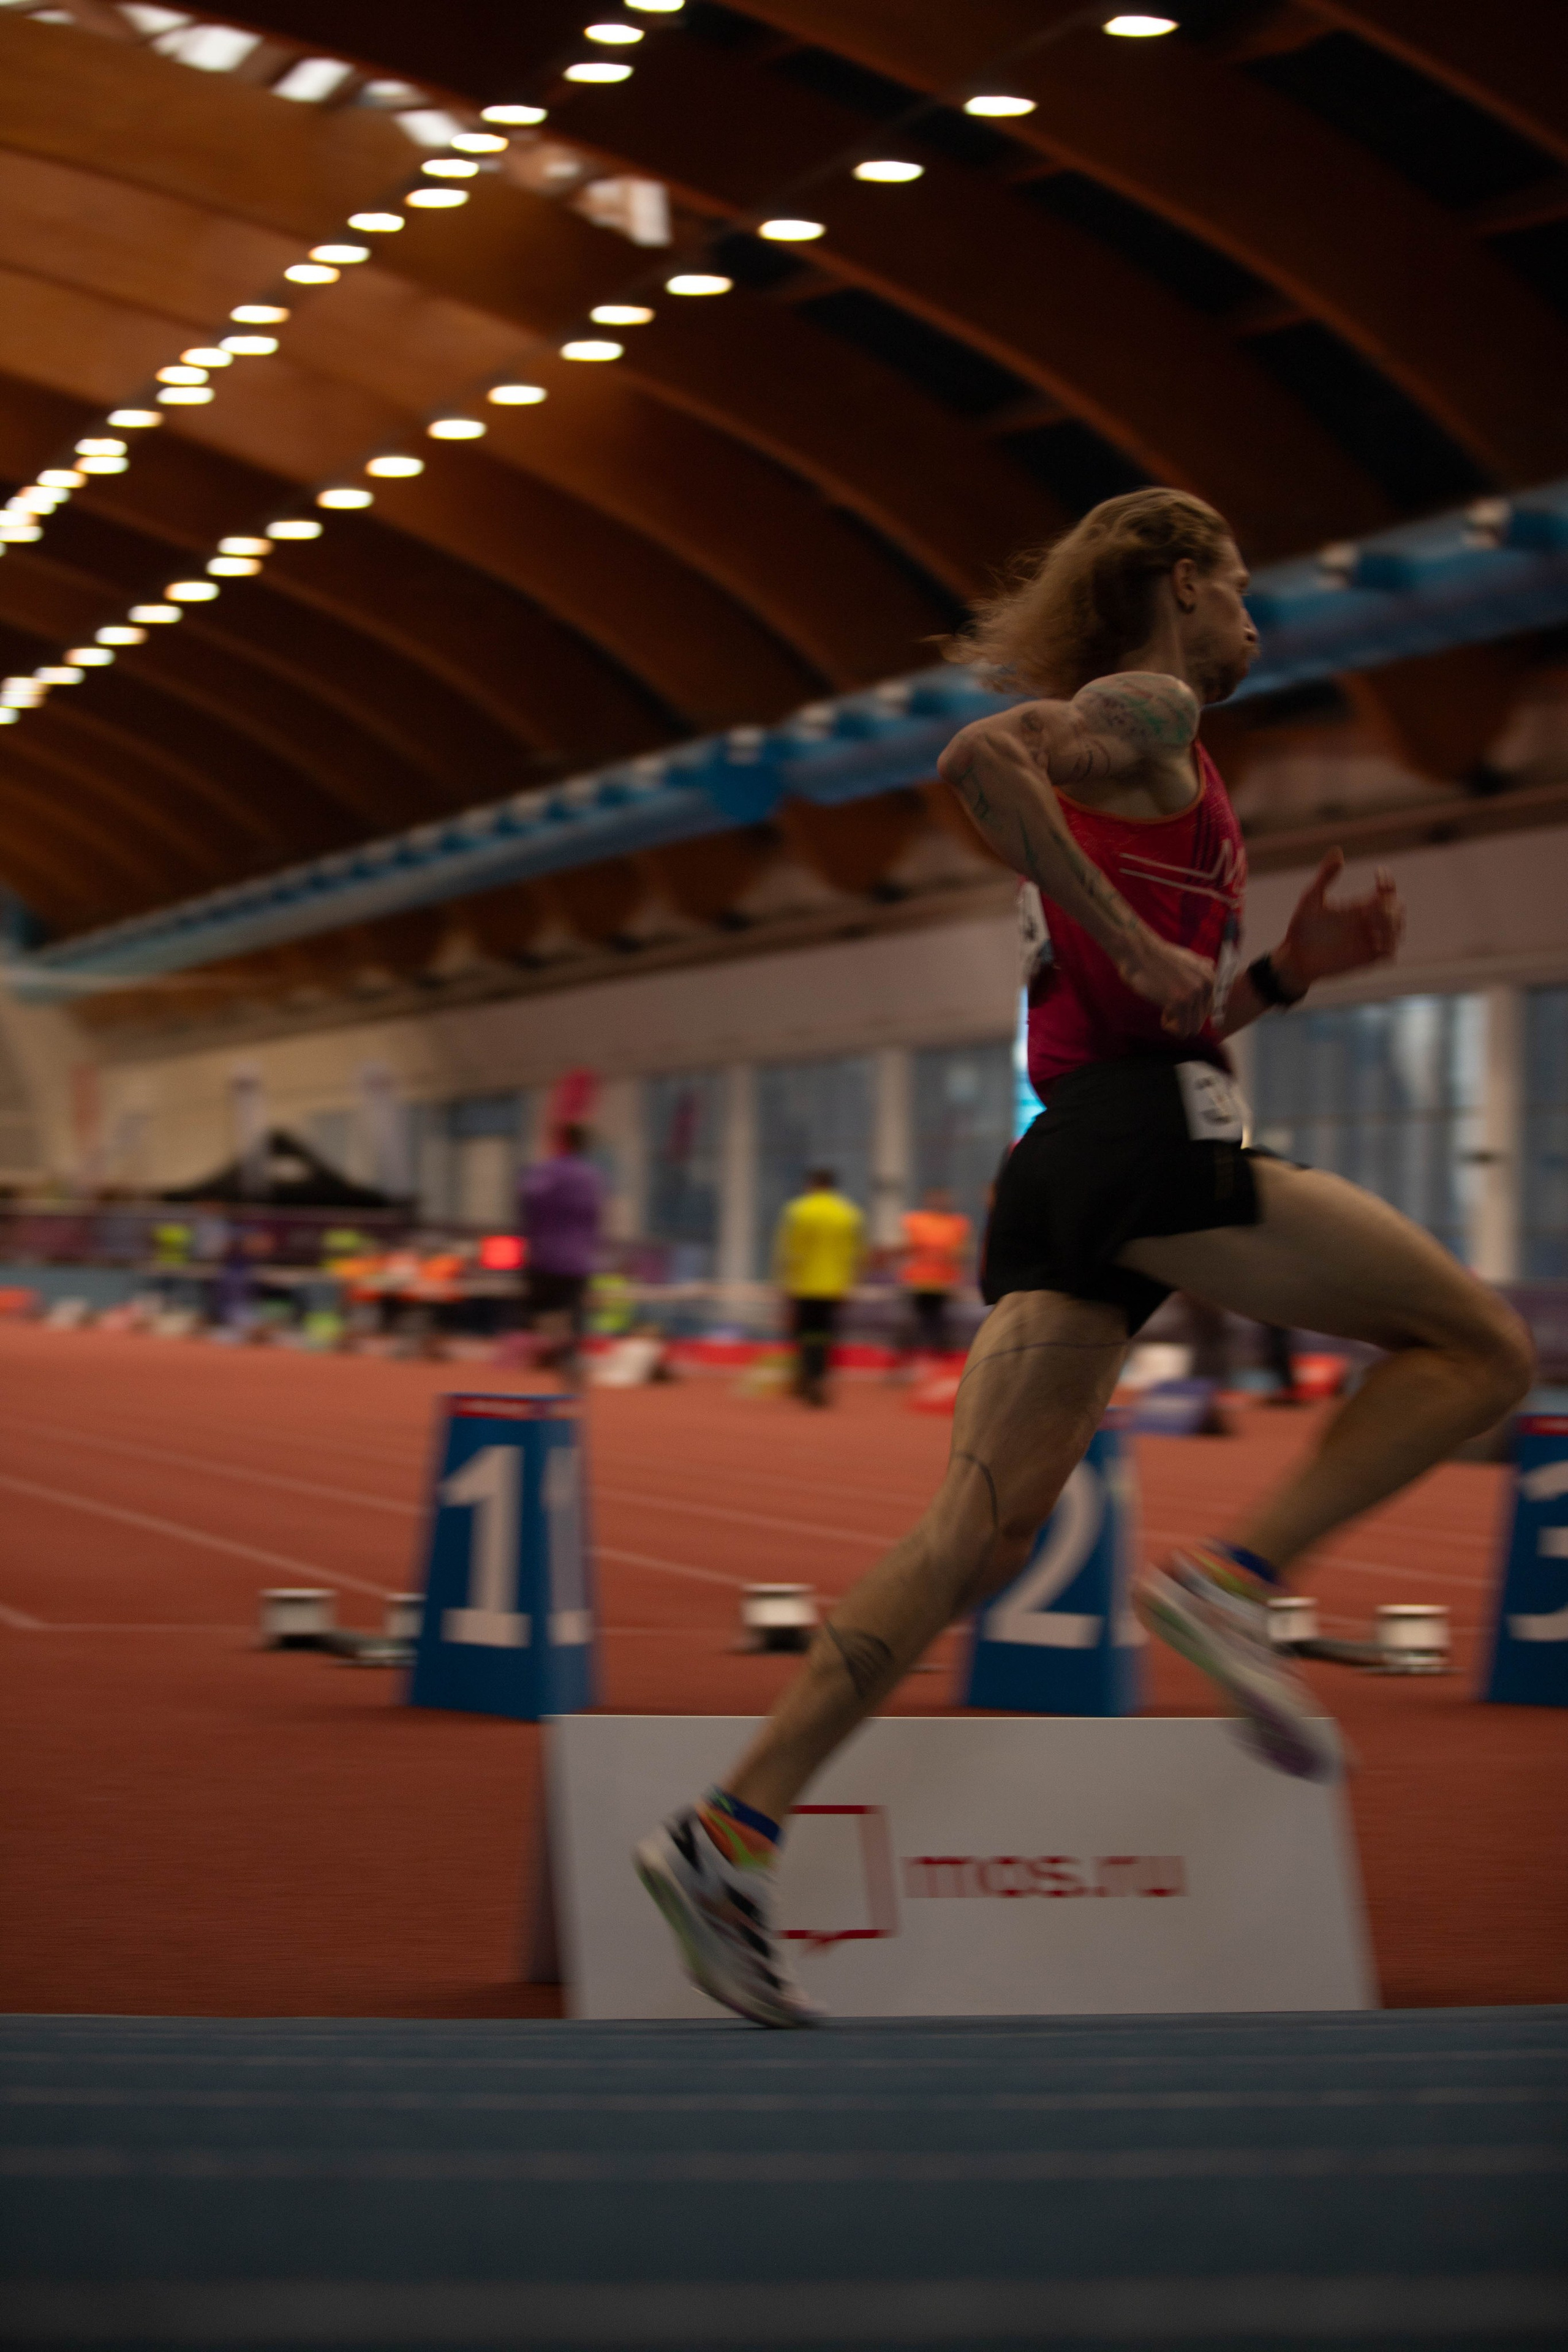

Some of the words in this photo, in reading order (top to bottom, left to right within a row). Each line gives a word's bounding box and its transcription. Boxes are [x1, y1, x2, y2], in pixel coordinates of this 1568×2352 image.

[439, 1444, 532, 1649] 1
[983, 1460, 1104, 1649] 2
[901, 1856, 1188, 1898] mos.ru
